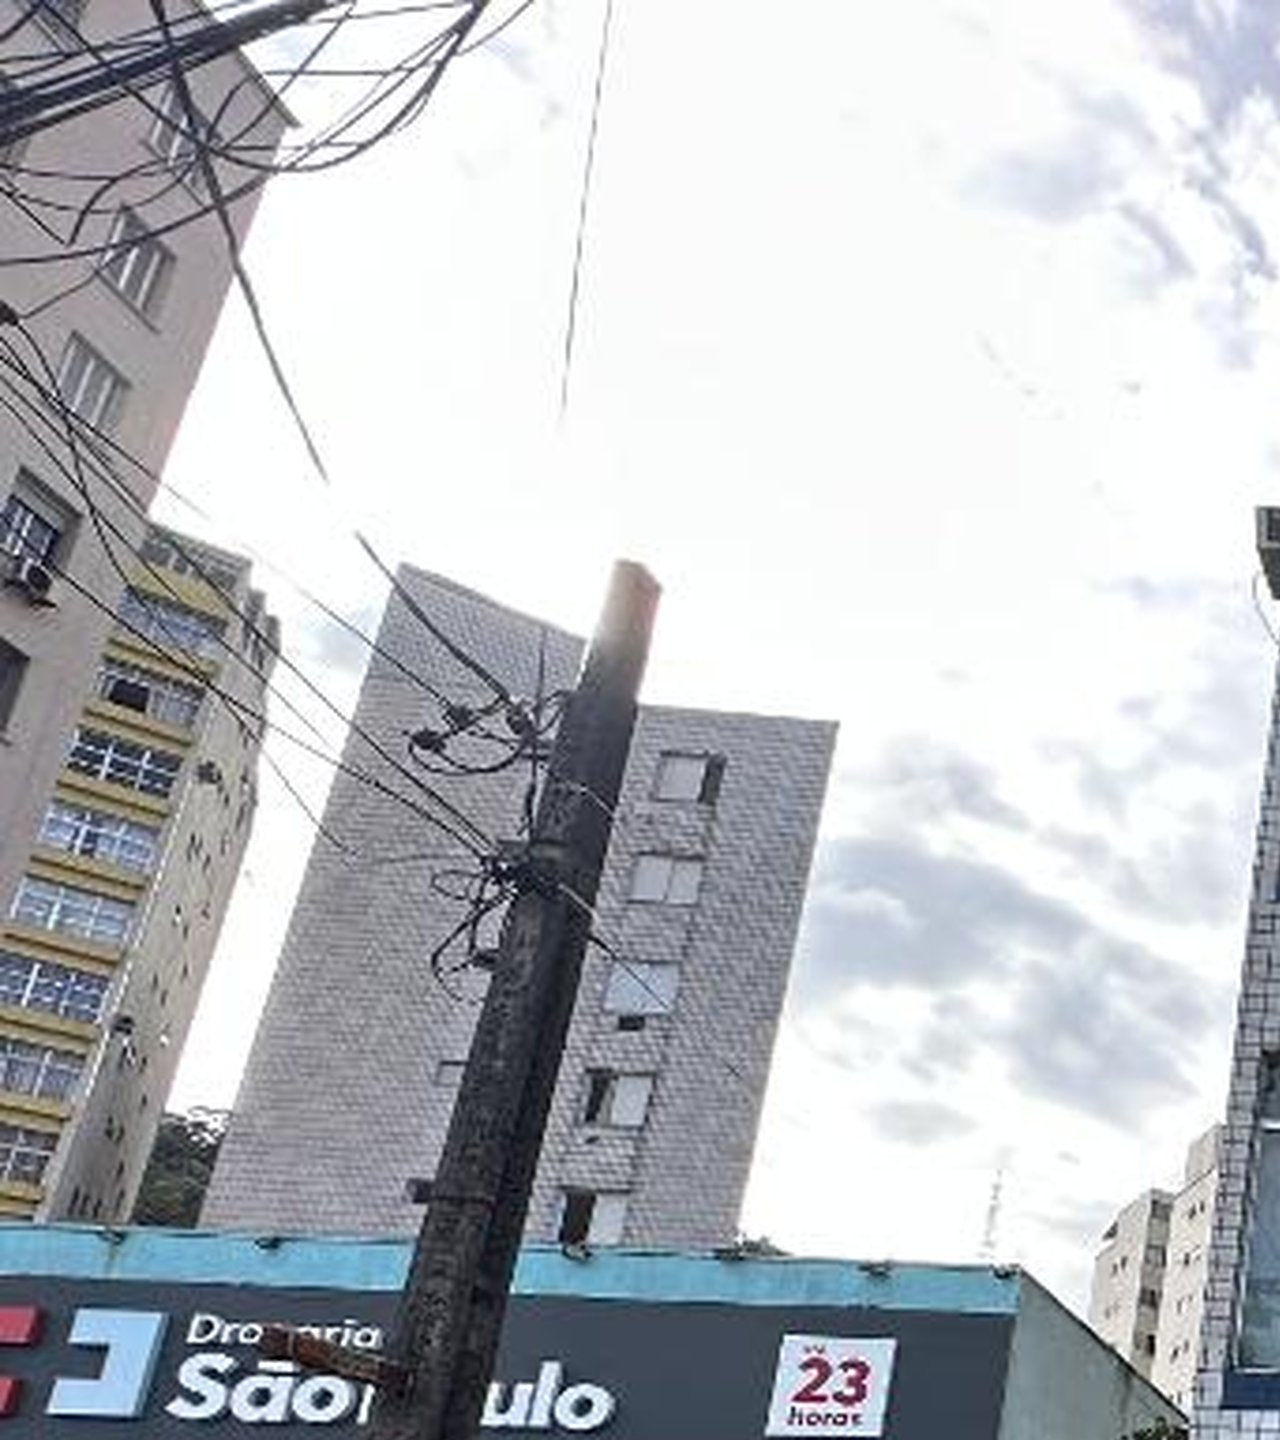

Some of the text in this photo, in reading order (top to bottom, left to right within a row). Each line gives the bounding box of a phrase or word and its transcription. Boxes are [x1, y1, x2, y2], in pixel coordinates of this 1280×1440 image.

[187, 1313, 382, 1347] Droaria
[165, 1353, 615, 1430] São ulo
[791, 1357, 870, 1406] 23
